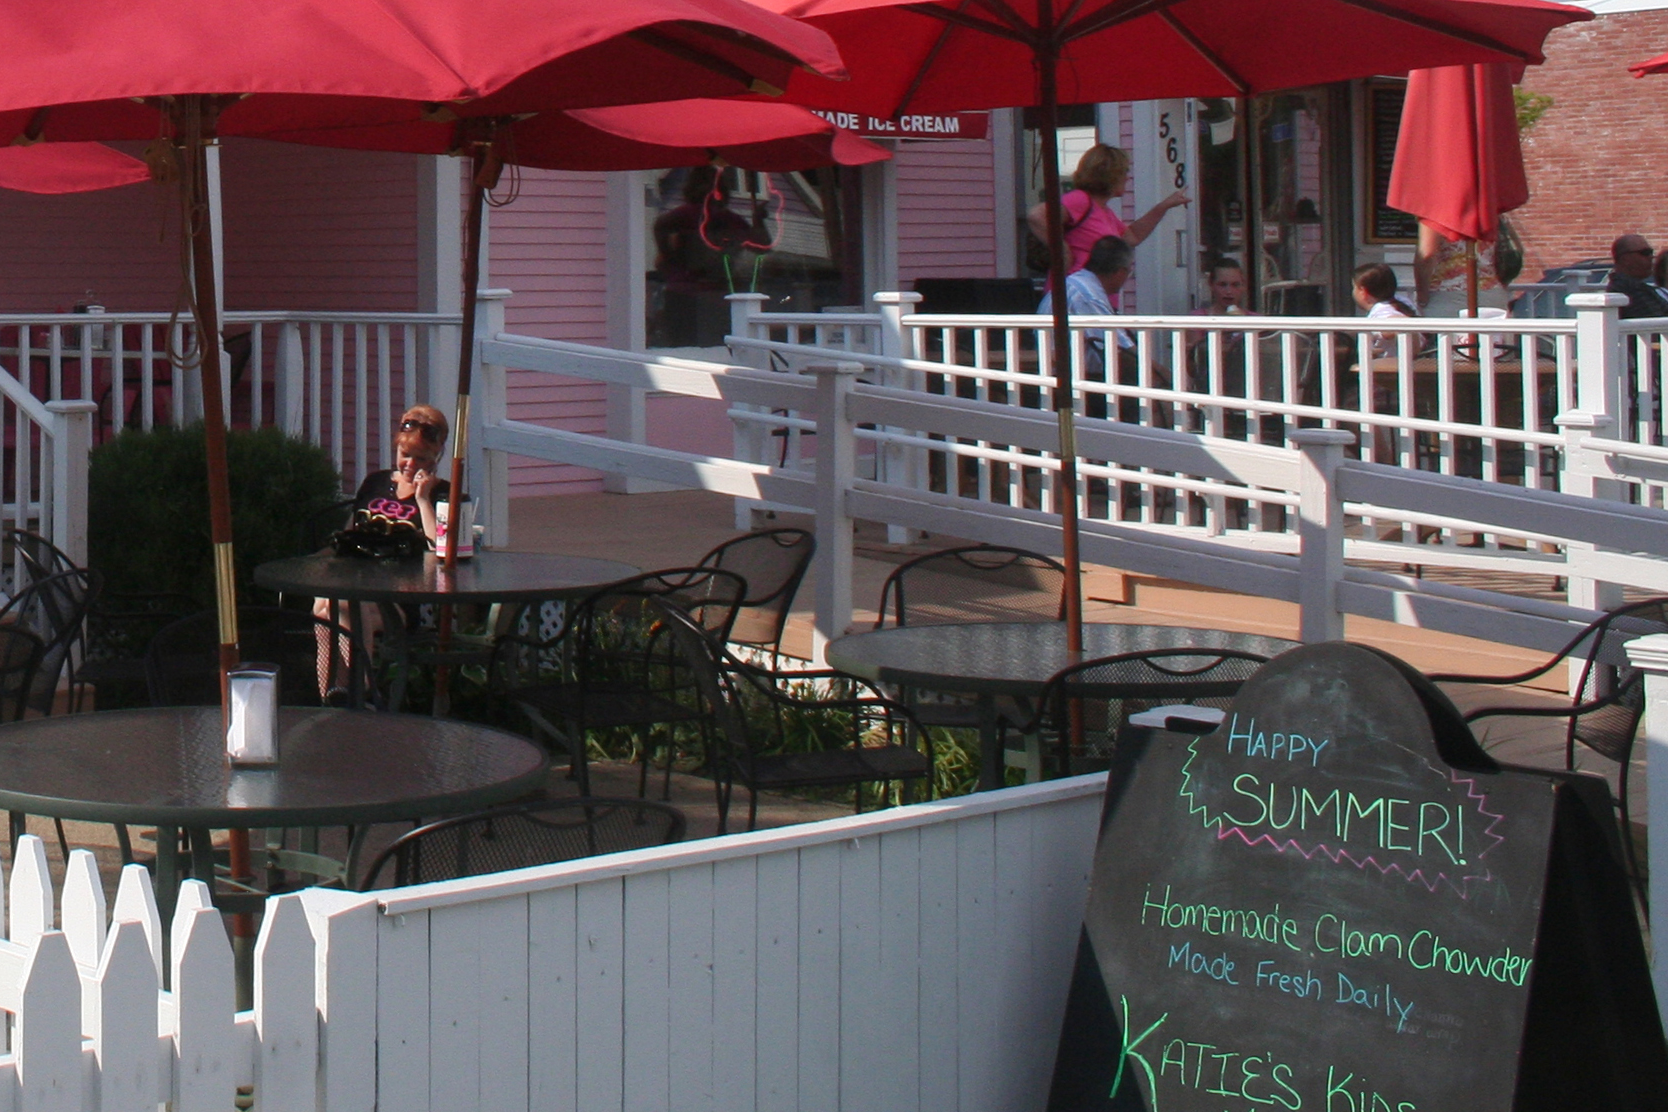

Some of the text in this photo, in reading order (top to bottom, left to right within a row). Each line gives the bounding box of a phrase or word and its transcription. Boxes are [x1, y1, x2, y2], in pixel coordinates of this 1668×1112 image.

[867, 116, 897, 131] ICE
[899, 115, 960, 134] CREAM
[1227, 712, 1329, 768] HAPPY
[1222, 773, 1468, 866] SUMMER!
[1140, 883, 1534, 987] Homemade Clam Chowder
[1167, 941, 1239, 986] Made
[1255, 960, 1322, 1001] Fresh
[1335, 971, 1414, 1034] Daily
